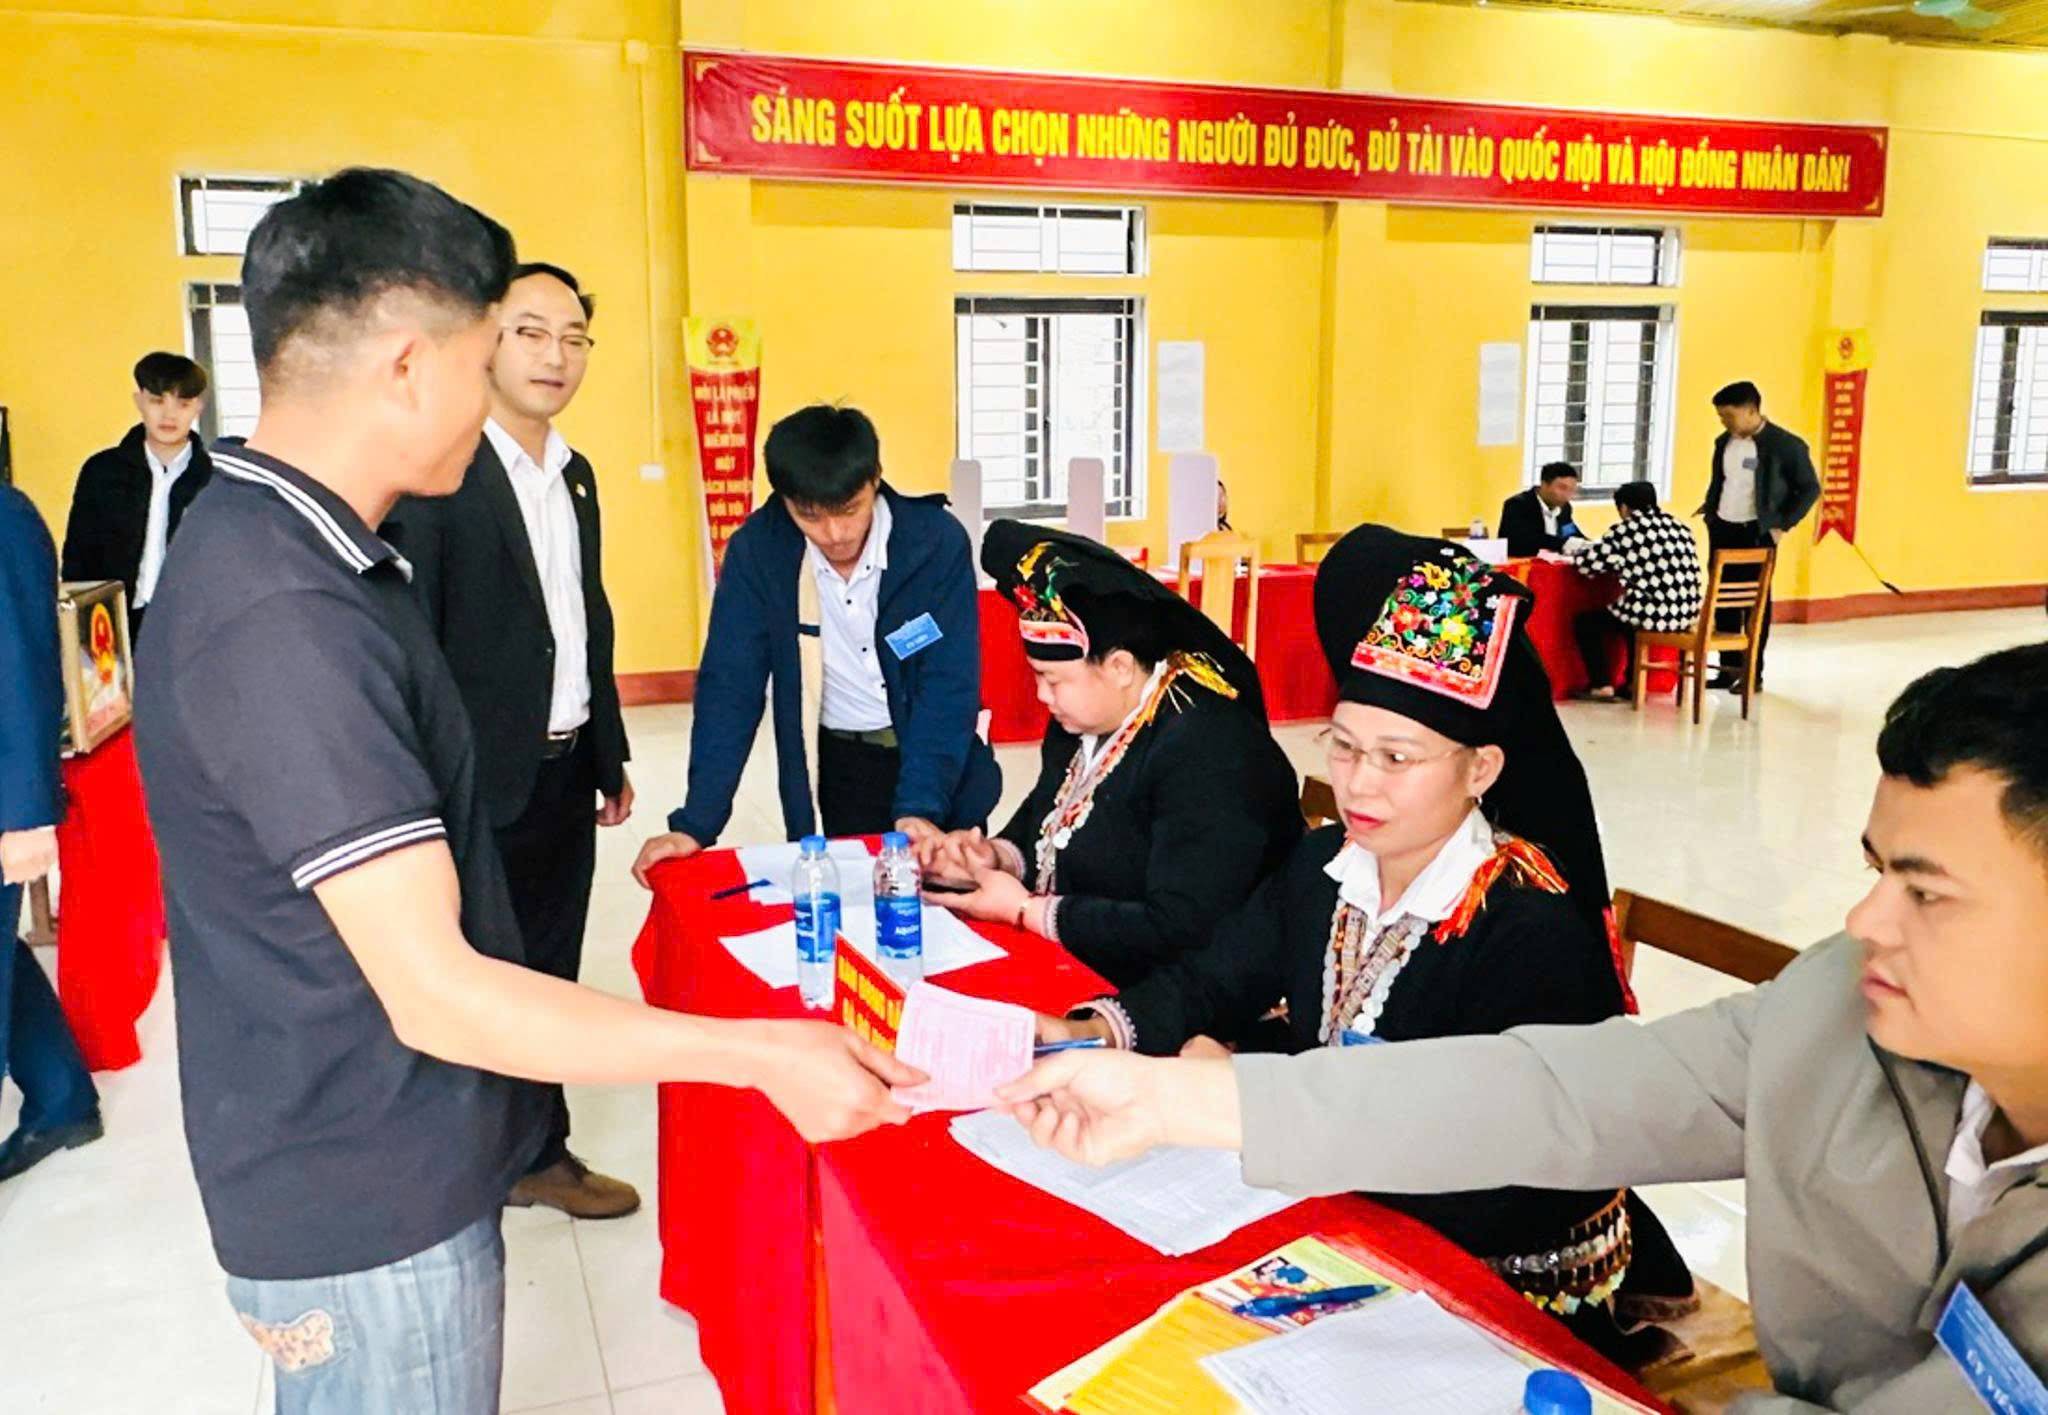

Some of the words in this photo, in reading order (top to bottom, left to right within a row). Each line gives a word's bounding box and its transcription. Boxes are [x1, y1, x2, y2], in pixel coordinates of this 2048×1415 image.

[752, 84, 836, 146] SÁNG
[845, 86, 922, 150] SUỐT
[929, 102, 984, 163] LỰA
[992, 107, 1069, 167] CHỌN
[1077, 107, 1170, 162] NHỮNG
[1178, 112, 1257, 166] NGƯỜI
[1264, 111, 1298, 168] ĐỦ
[1304, 118, 1361, 177] ĐỨC,
[1368, 117, 1400, 172] ĐỦ
[1407, 124, 1443, 176] TÀI
[1450, 127, 1494, 178] VÀO
[1500, 125, 1560, 184] QUỐC
[1564, 133, 1602, 192] HỘI
[1608, 135, 1634, 185] VÀ
[1640, 138, 1676, 196] HỘI
[1741, 144, 1799, 191] NHÂN
[1802, 146, 1851, 192] DÂN!
